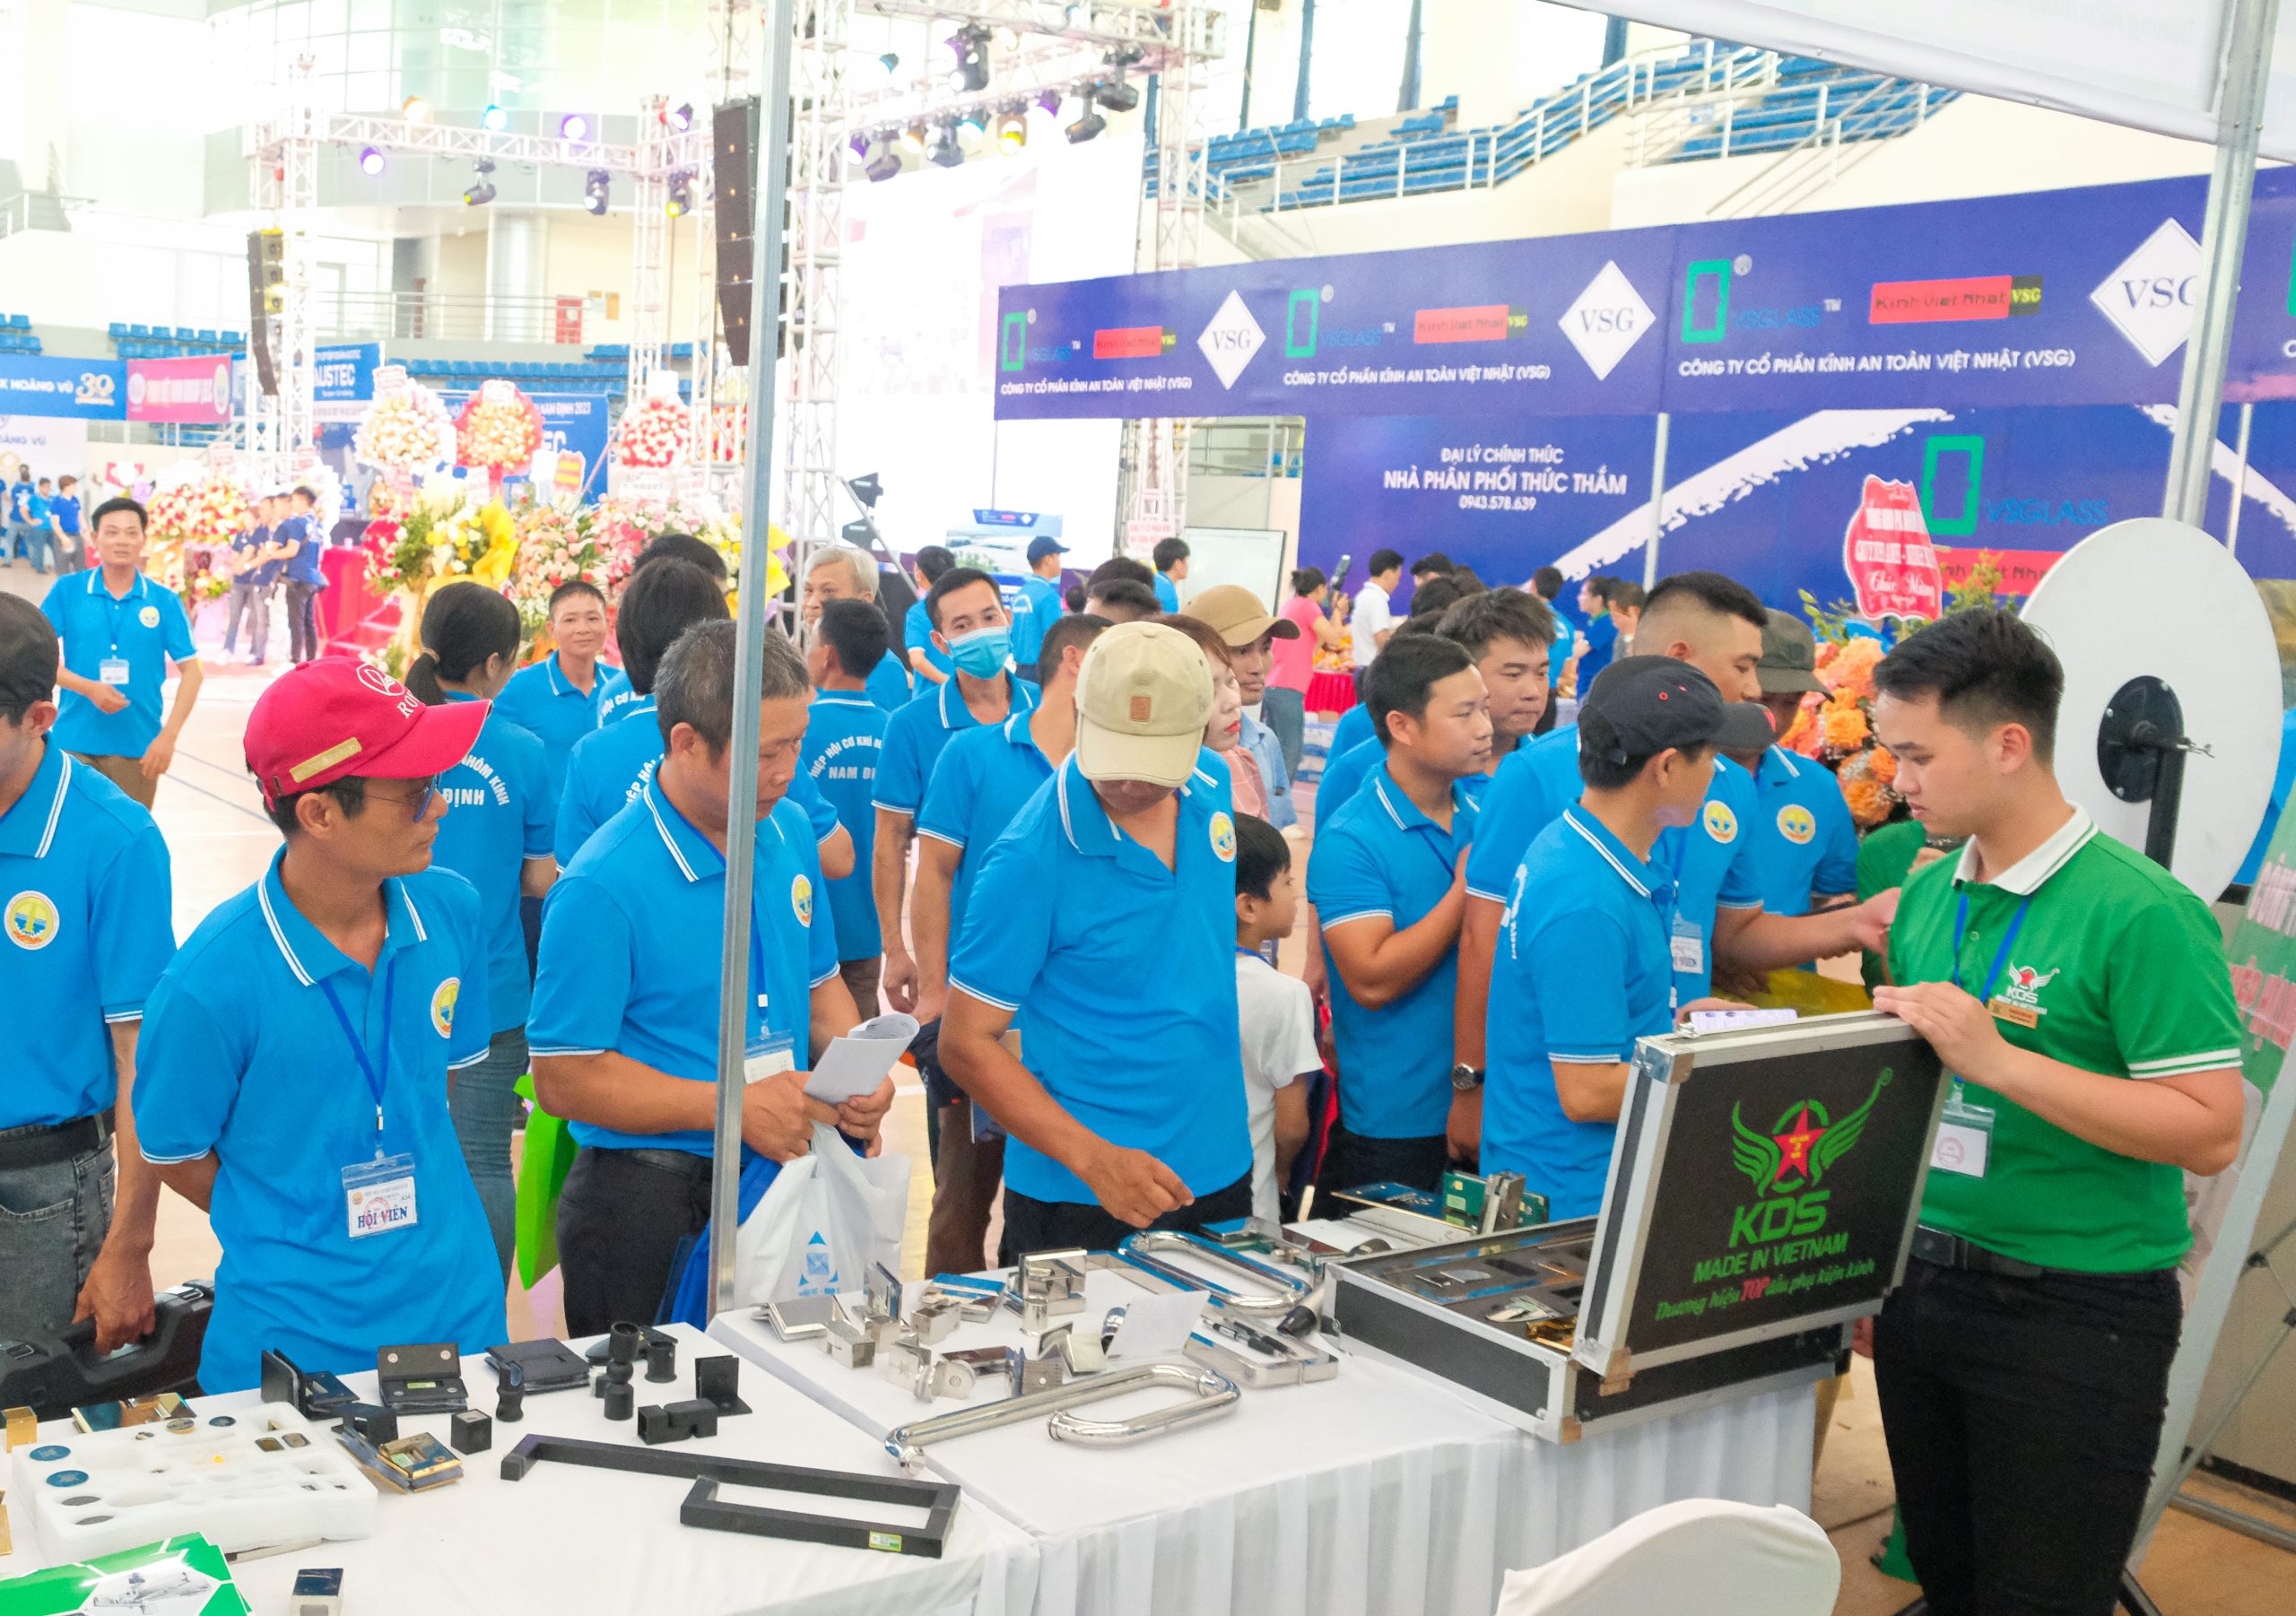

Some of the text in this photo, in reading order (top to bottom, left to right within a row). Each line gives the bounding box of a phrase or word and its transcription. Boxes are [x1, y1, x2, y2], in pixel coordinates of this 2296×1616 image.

[2011, 287, 2042, 304] VSG
[1579, 307, 1634, 334] VSG
[1213, 328, 1251, 351] VSG
[1678, 347, 2076, 377] CÔNG TY CỔ PHẦN KÍNH AN TOÀN VIỆT NHẬT (VSG)
[1283, 370, 1316, 386] CÔNG
[1317, 371, 1329, 385] TY
[1407, 369, 1424, 383] AN
[1425, 365, 1457, 382] TOÀN
[1458, 364, 1483, 384] VIỆT
[1440, 447, 1465, 465] ĐẠI
[1465, 444, 1483, 463] LÝ
[1483, 444, 1526, 464] CHÍNH
[1384, 465, 1421, 490] NHÀ
[1422, 465, 1471, 491] PHÂN
[1474, 465, 1518, 491] PHỐI
[1985, 498, 2109, 526] VSGLASS
[828, 766, 858, 779] NAM
[442, 787, 485, 807] ĐỊNH
[358, 1204, 408, 1229] HỘI VIÊN
[1692, 1231, 1849, 1283] MADE IN VIETNAM
